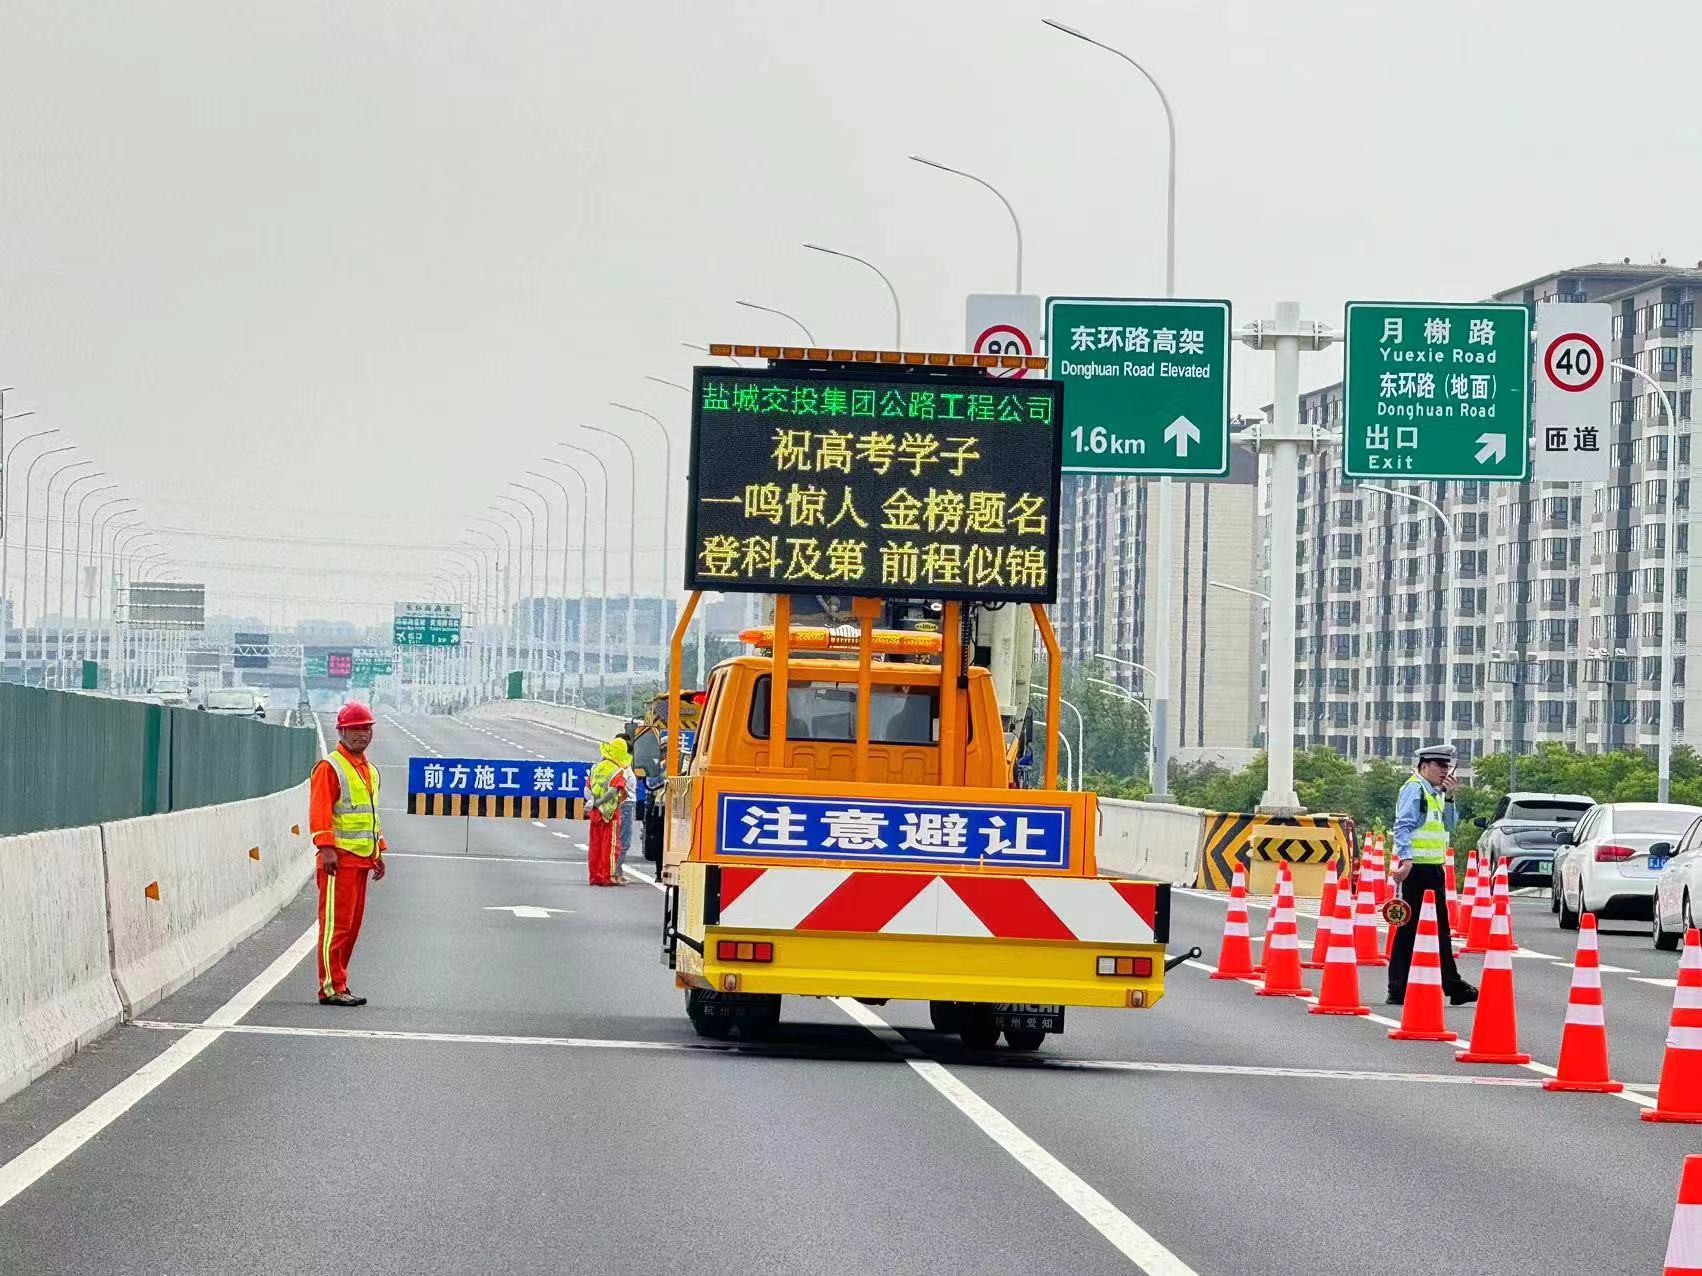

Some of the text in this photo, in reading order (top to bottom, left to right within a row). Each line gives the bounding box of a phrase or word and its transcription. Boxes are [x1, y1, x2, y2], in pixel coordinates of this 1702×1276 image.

[1070, 325, 1204, 355] 东环路高架
[1379, 317, 1496, 346] 月榭路
[1061, 360, 1210, 379] Donghuan Road Elevated
[1379, 347, 1497, 364] Yuexie Road
[1555, 348, 1592, 376] 40
[703, 382, 1053, 424] 盐城交投集团公路工程公司
[1377, 401, 1496, 420] Donghuan Road
[1365, 423, 1418, 450] 出口
[1545, 426, 1600, 452] 匝道
[770, 427, 981, 477] 祝高考学子
[1368, 454, 1414, 470] Exit
[701, 482, 1047, 535] 一鸣惊人 金榜题名
[698, 534, 1047, 588] 登科及第 前程似锦
[423, 762, 590, 793] 前方施工 禁止
[740, 805, 1048, 857] 注意避让
